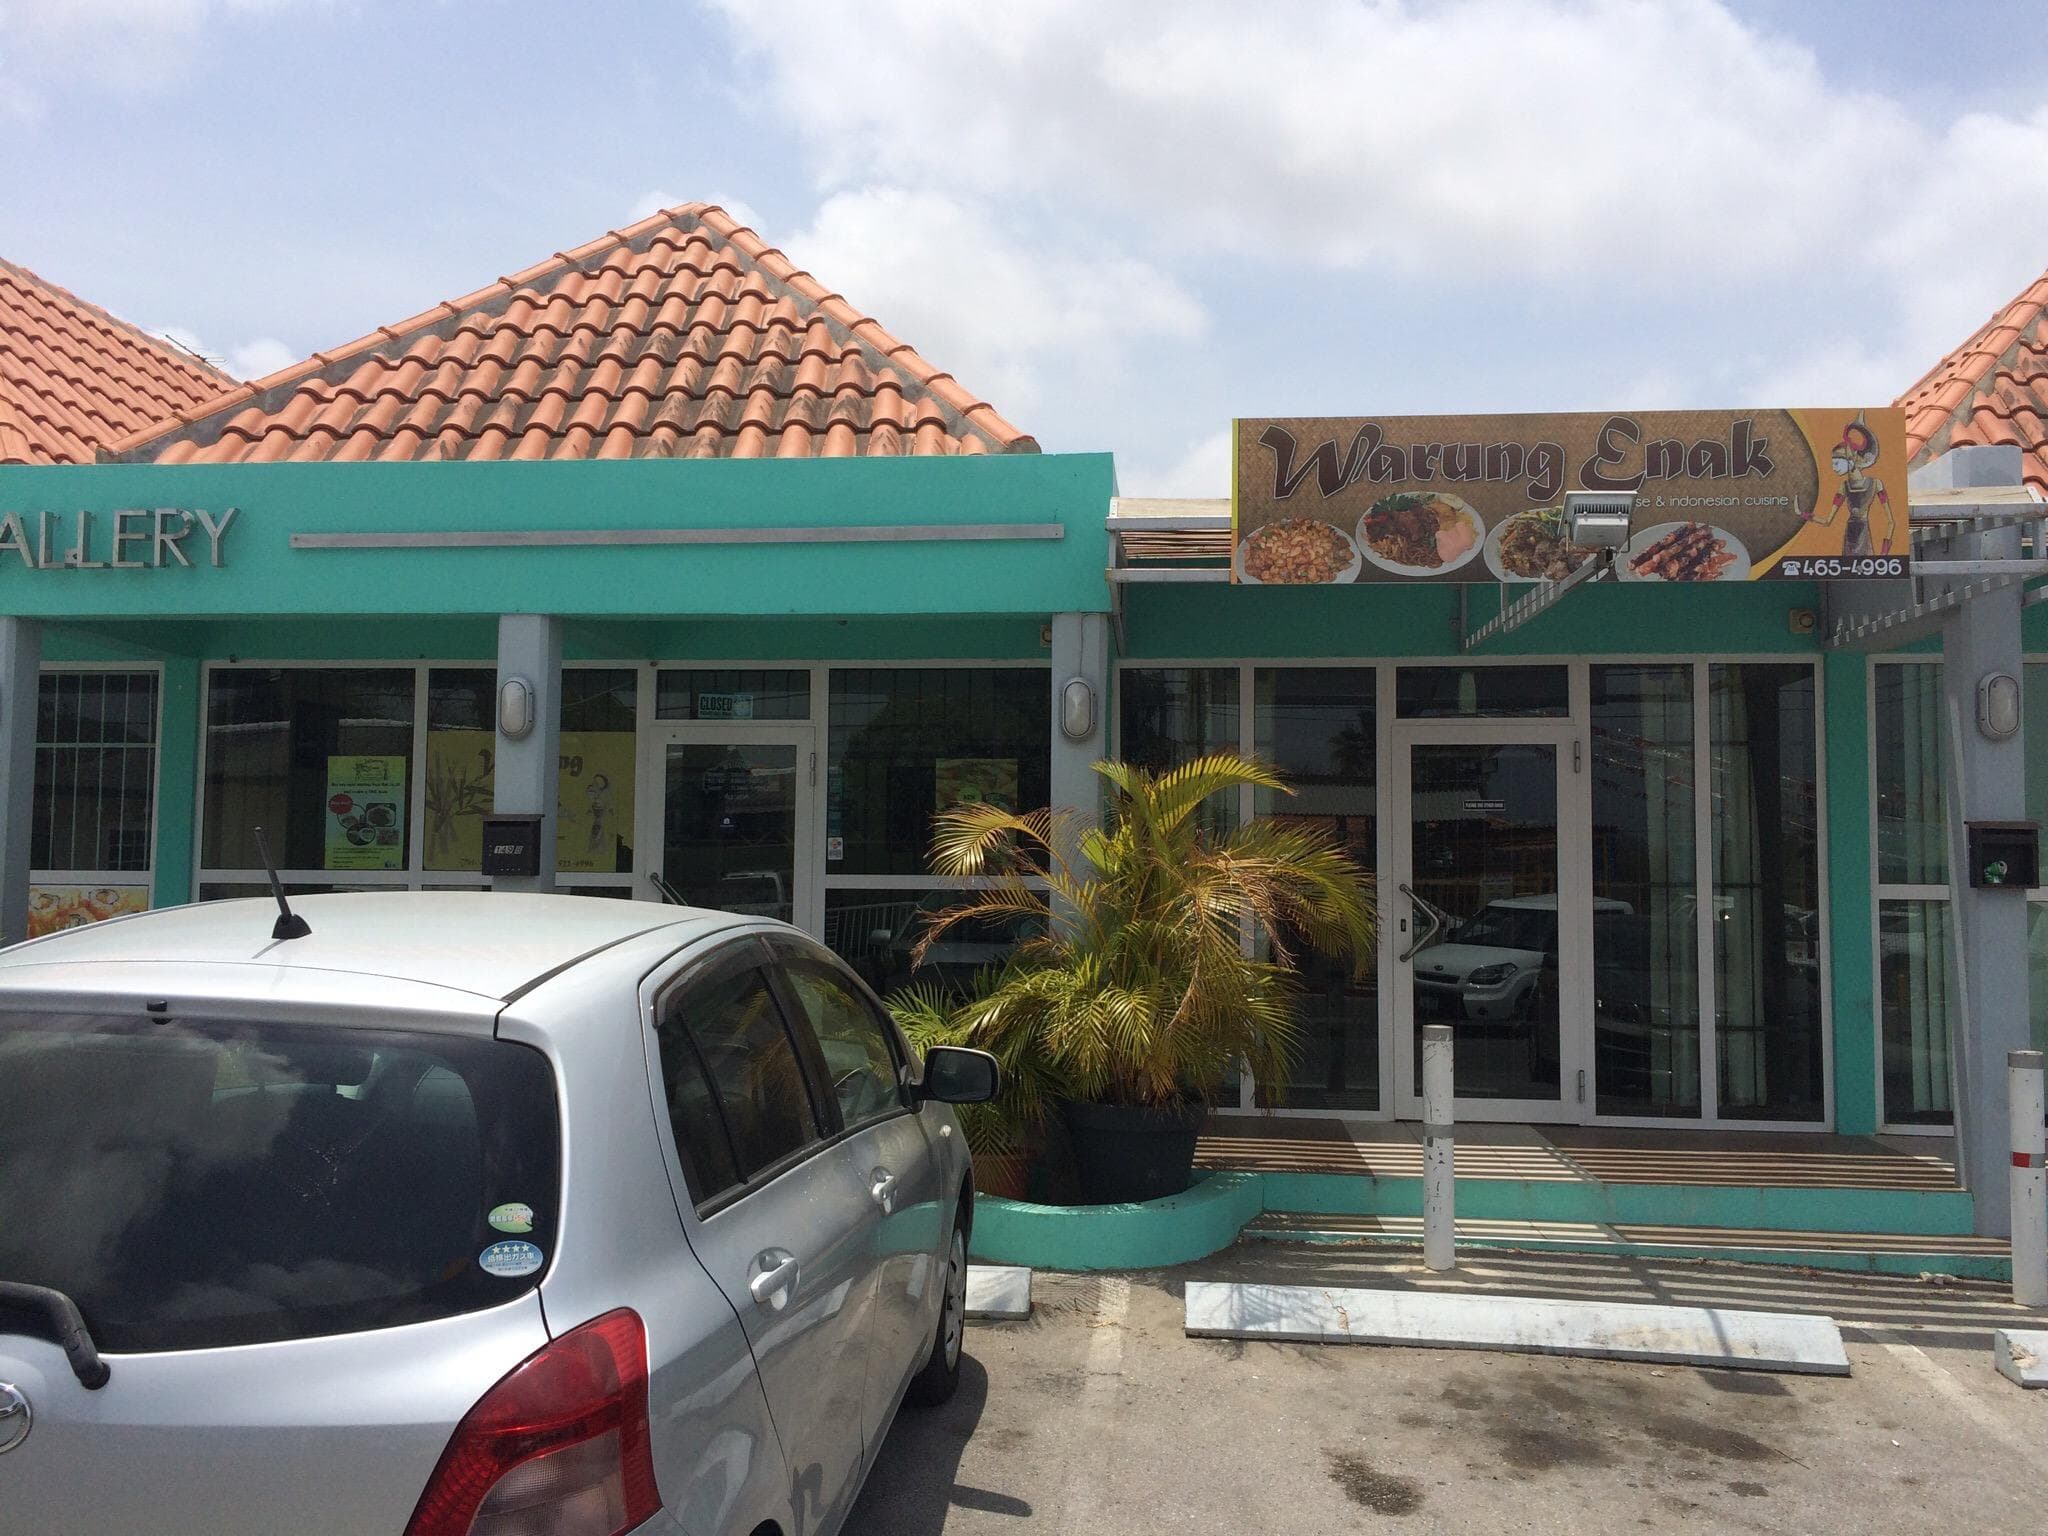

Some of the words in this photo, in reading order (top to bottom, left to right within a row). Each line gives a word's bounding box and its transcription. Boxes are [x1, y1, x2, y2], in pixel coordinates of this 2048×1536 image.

[1258, 423, 1566, 502] Warung
[1578, 415, 1774, 491] Enak
[1655, 495, 1665, 507] &
[1669, 495, 1740, 507] indonesian
[1744, 495, 1789, 506] cuisine
[1803, 558, 1902, 576] 465-4996
[700, 696, 733, 711] CLOSED
